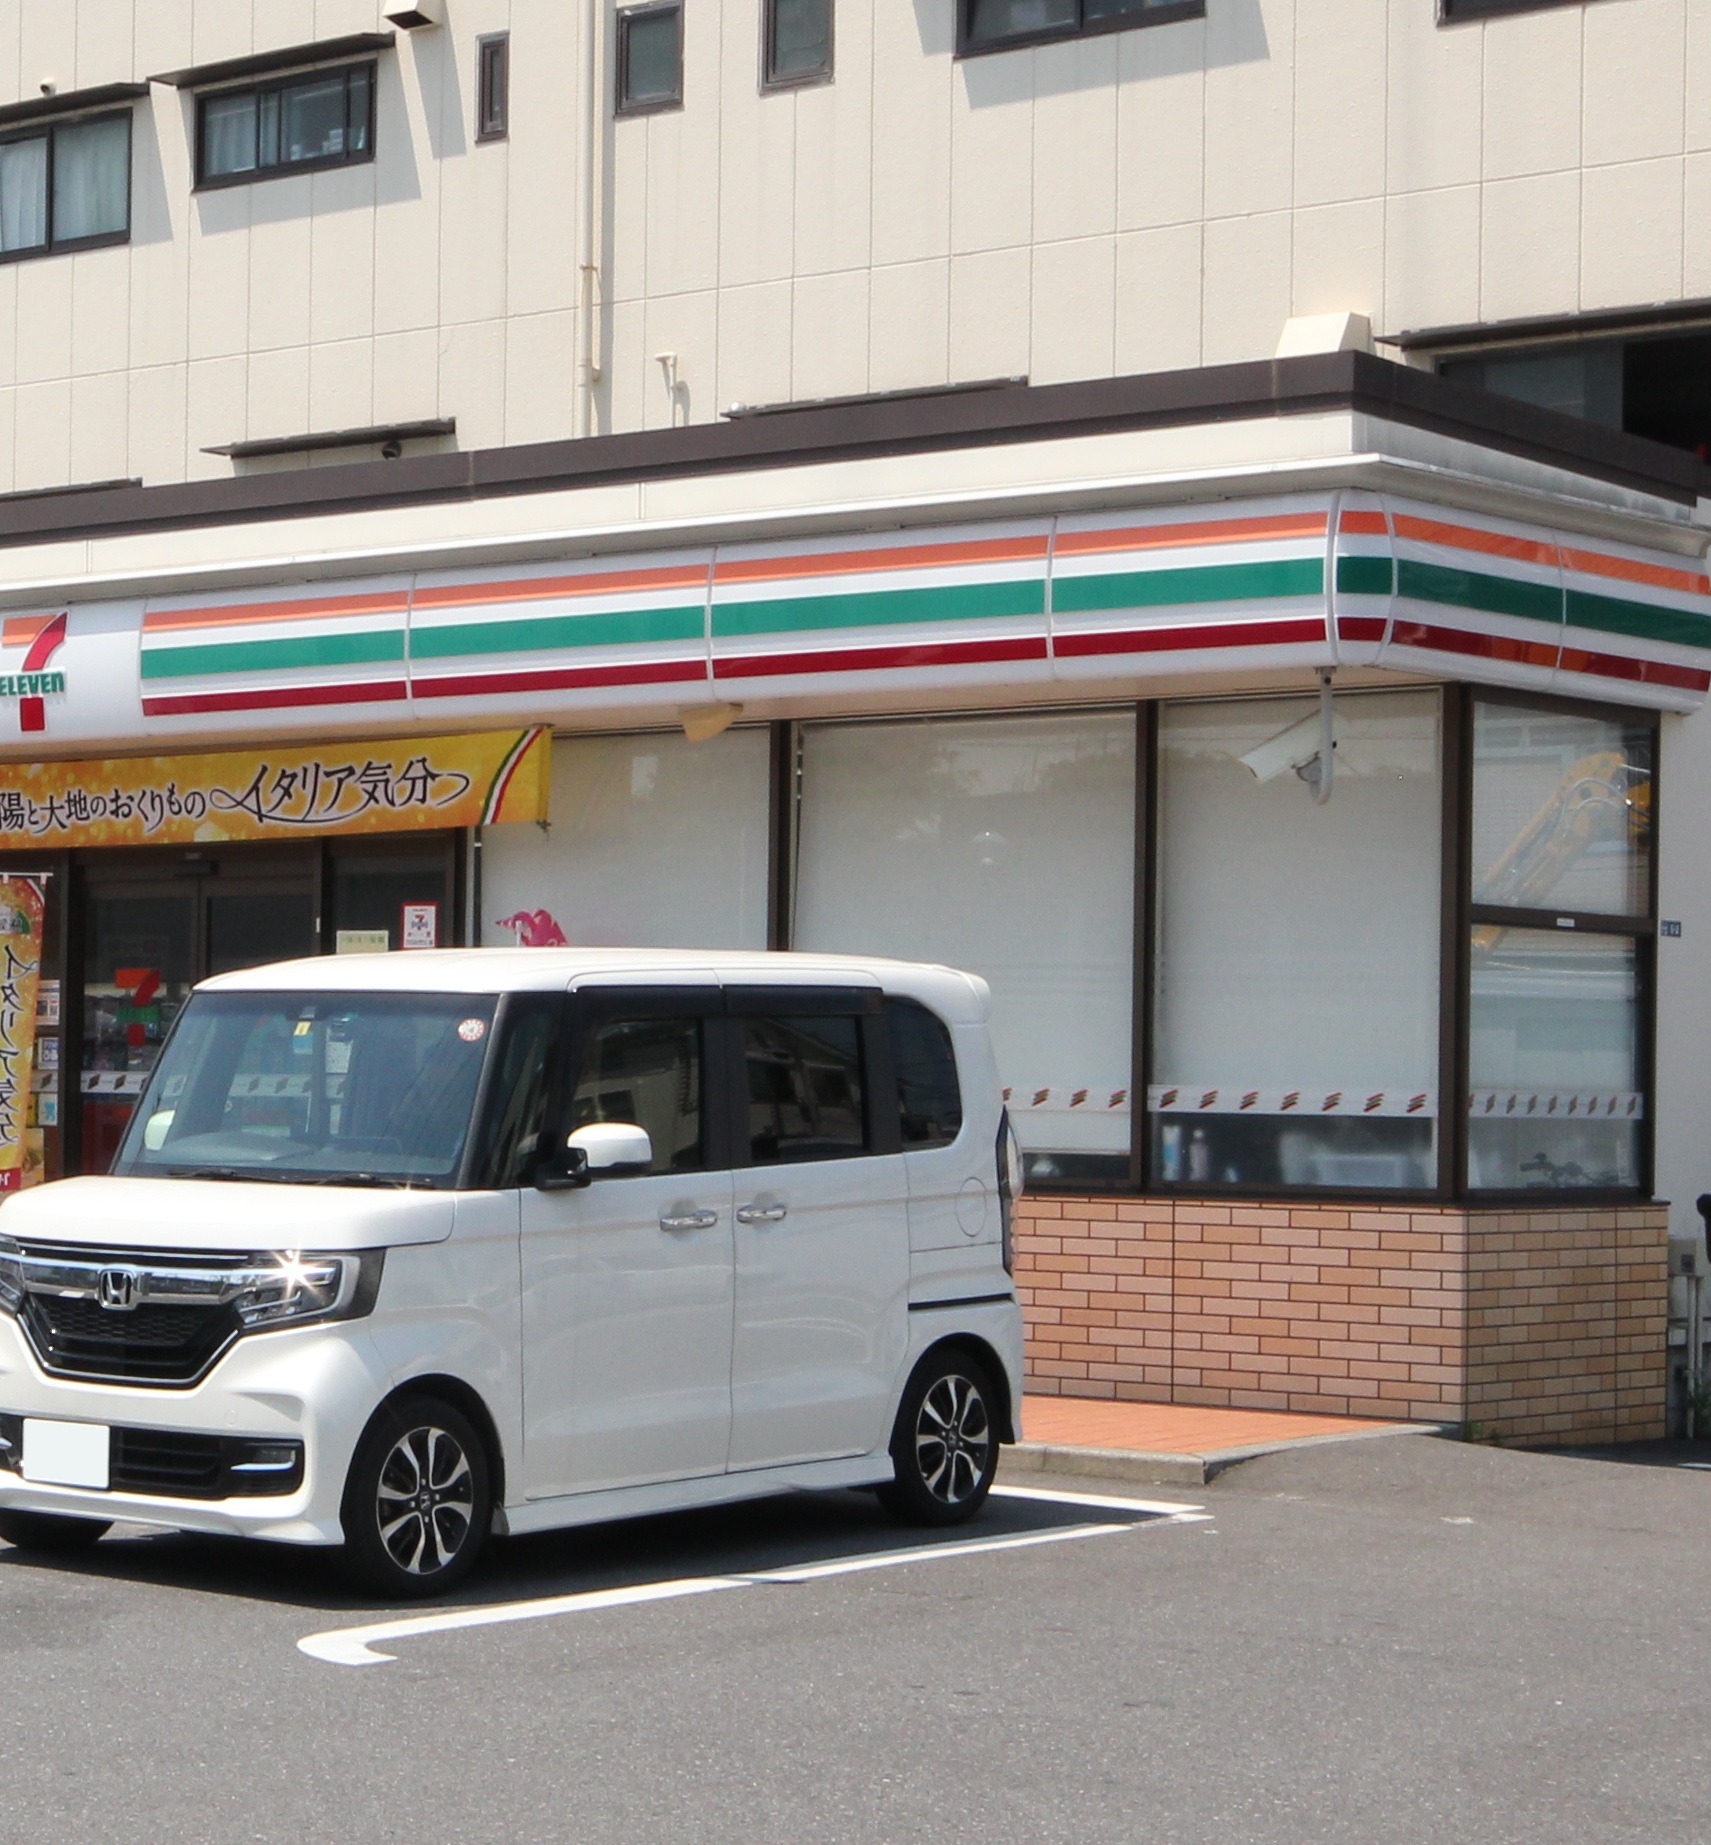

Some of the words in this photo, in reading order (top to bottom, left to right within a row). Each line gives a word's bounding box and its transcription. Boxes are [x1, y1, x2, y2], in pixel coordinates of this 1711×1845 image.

[1, 611, 68, 732] 7
[210, 756, 470, 825] イタリア気分
